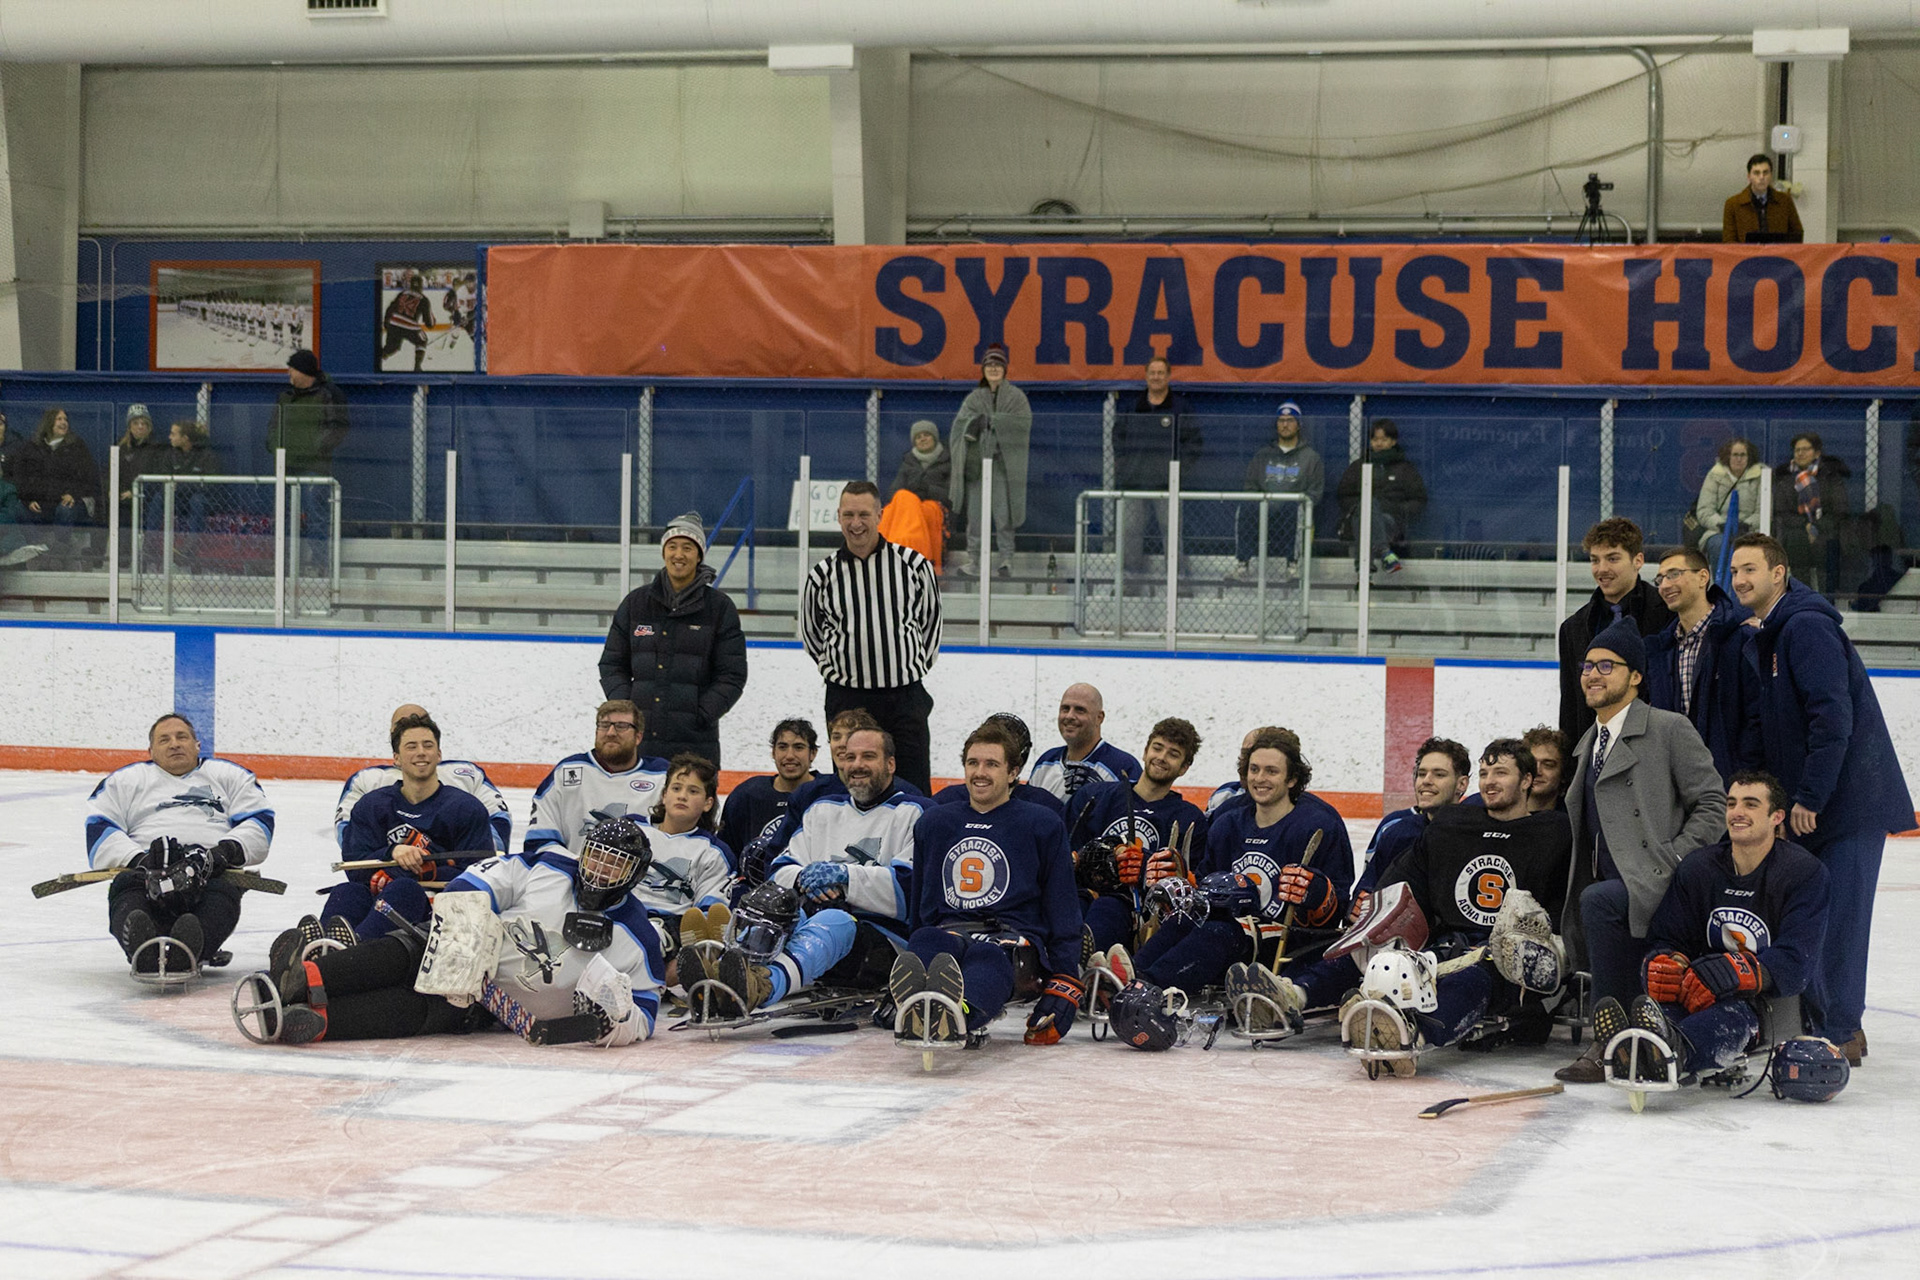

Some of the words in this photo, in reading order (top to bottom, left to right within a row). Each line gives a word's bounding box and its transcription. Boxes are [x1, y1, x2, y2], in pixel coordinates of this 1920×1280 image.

[875, 256, 1564, 369] SYRACUSE
[1622, 255, 1920, 374] HOC
[1108, 820, 1157, 844] SYRCUSE
[1482, 831, 1511, 839] CCM
[948, 840, 1002, 863] SYRACUSE
[960, 857, 985, 892] S
[1465, 857, 1514, 881] SYRACUSE
[962, 886, 1002, 910] HOCKEY
[1476, 873, 1504, 909] S
[1724, 888, 1755, 897] CCM
[1458, 899, 1480, 921] ACHA
[420, 912, 444, 974] CCM
